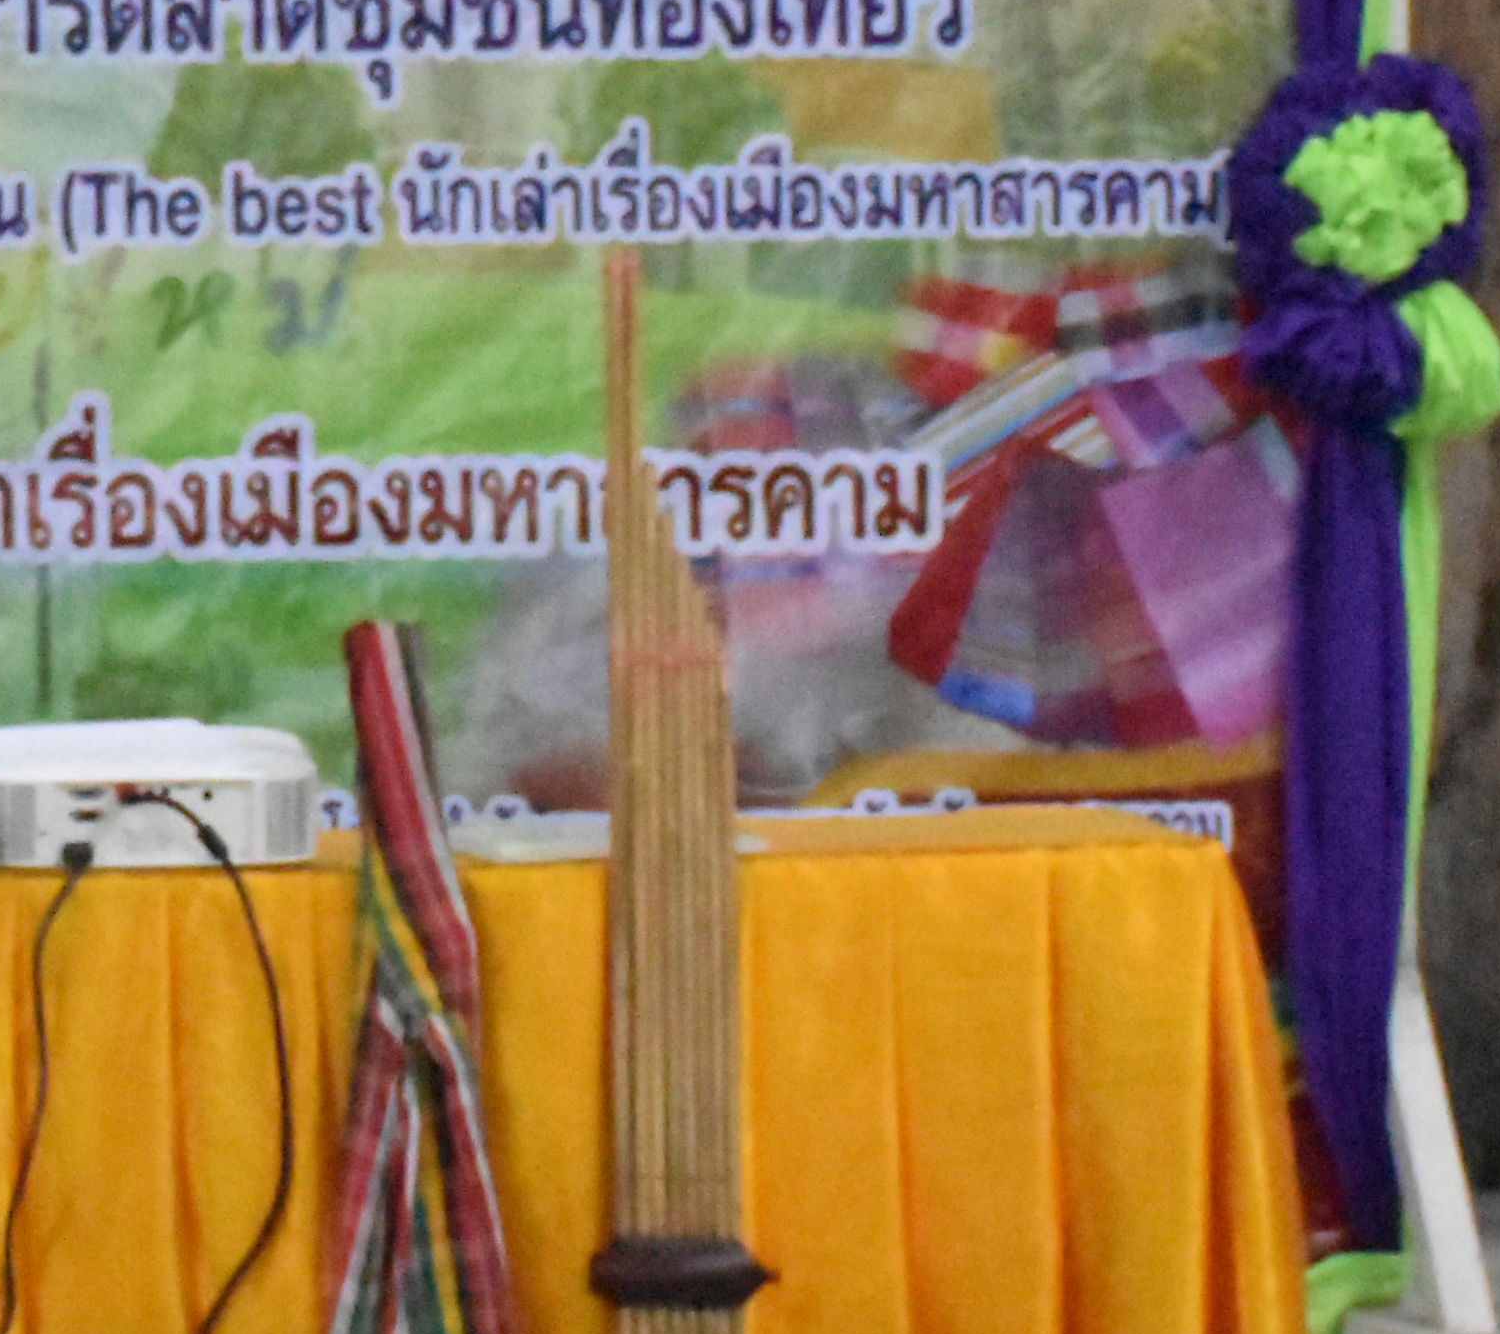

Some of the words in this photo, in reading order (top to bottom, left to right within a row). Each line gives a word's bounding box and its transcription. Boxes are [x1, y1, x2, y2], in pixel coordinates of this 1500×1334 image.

[61, 170, 202, 255] (The
[231, 170, 374, 237] best
[401, 131, 1235, 240] นักเล่าเรื่องเมืองมหาสารคาม
